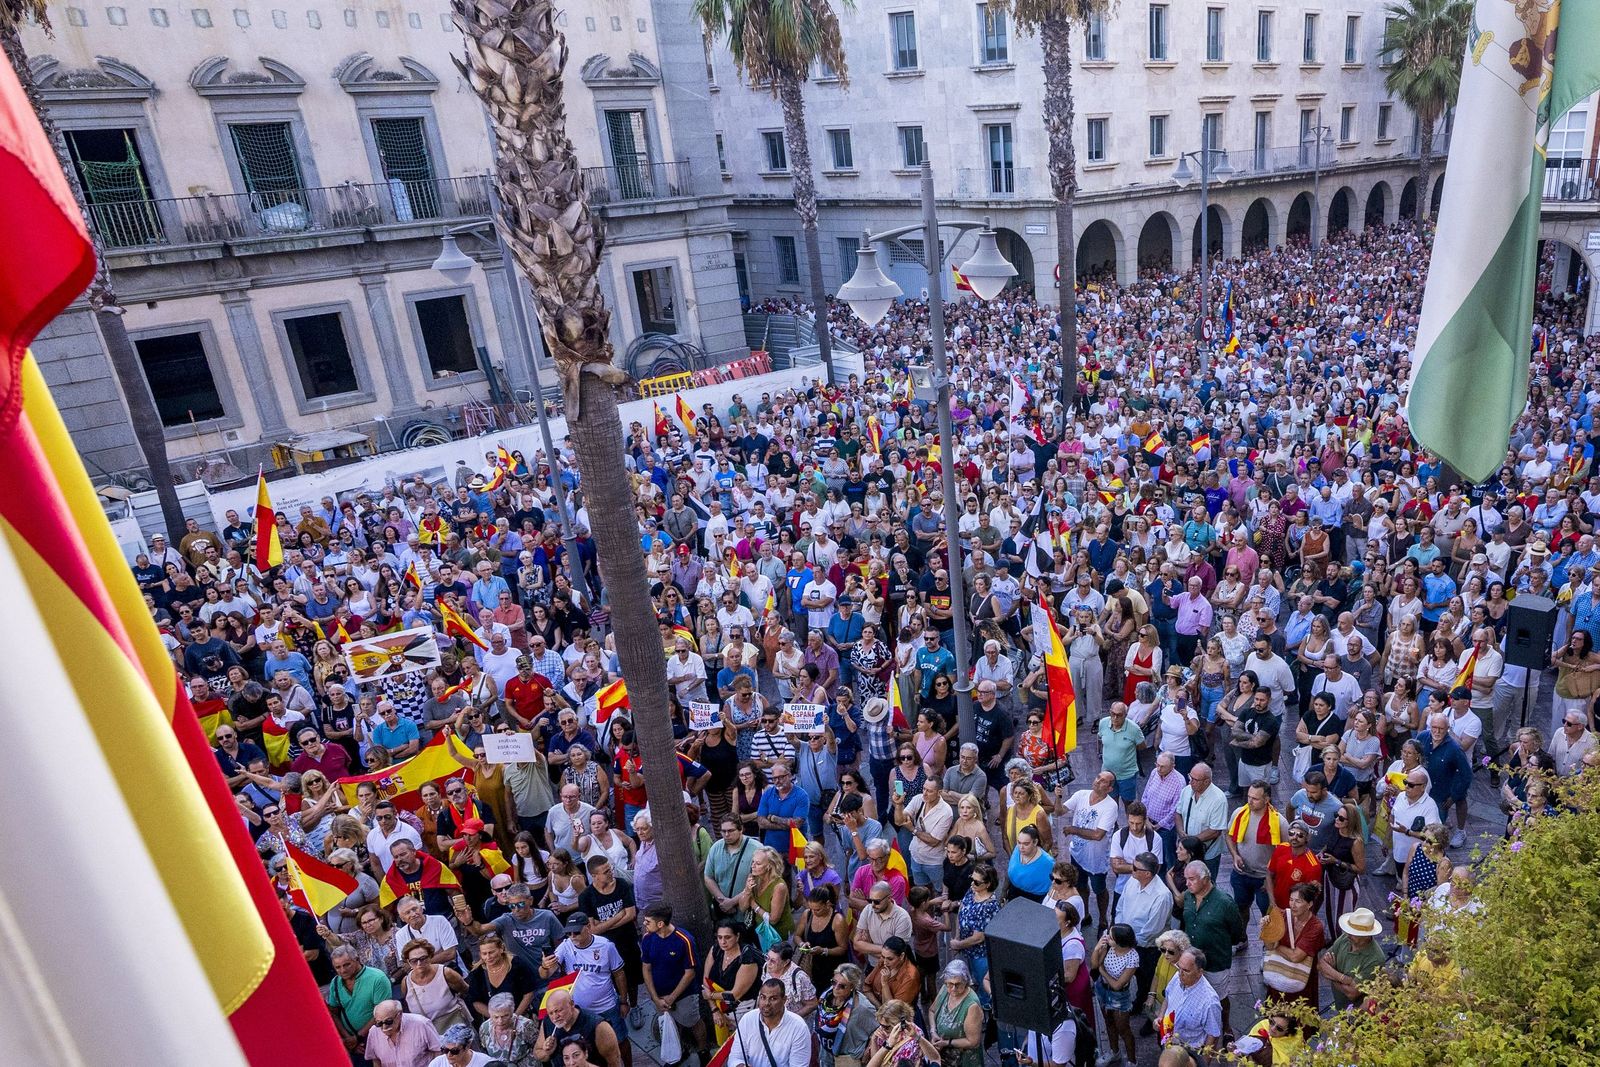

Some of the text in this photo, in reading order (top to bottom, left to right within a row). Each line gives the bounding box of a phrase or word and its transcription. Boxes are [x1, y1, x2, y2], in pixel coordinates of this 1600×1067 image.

[792, 710, 815, 718] ESPAÑA
[597, 903, 613, 914] NEVER
[512, 928, 546, 938] SILBON
